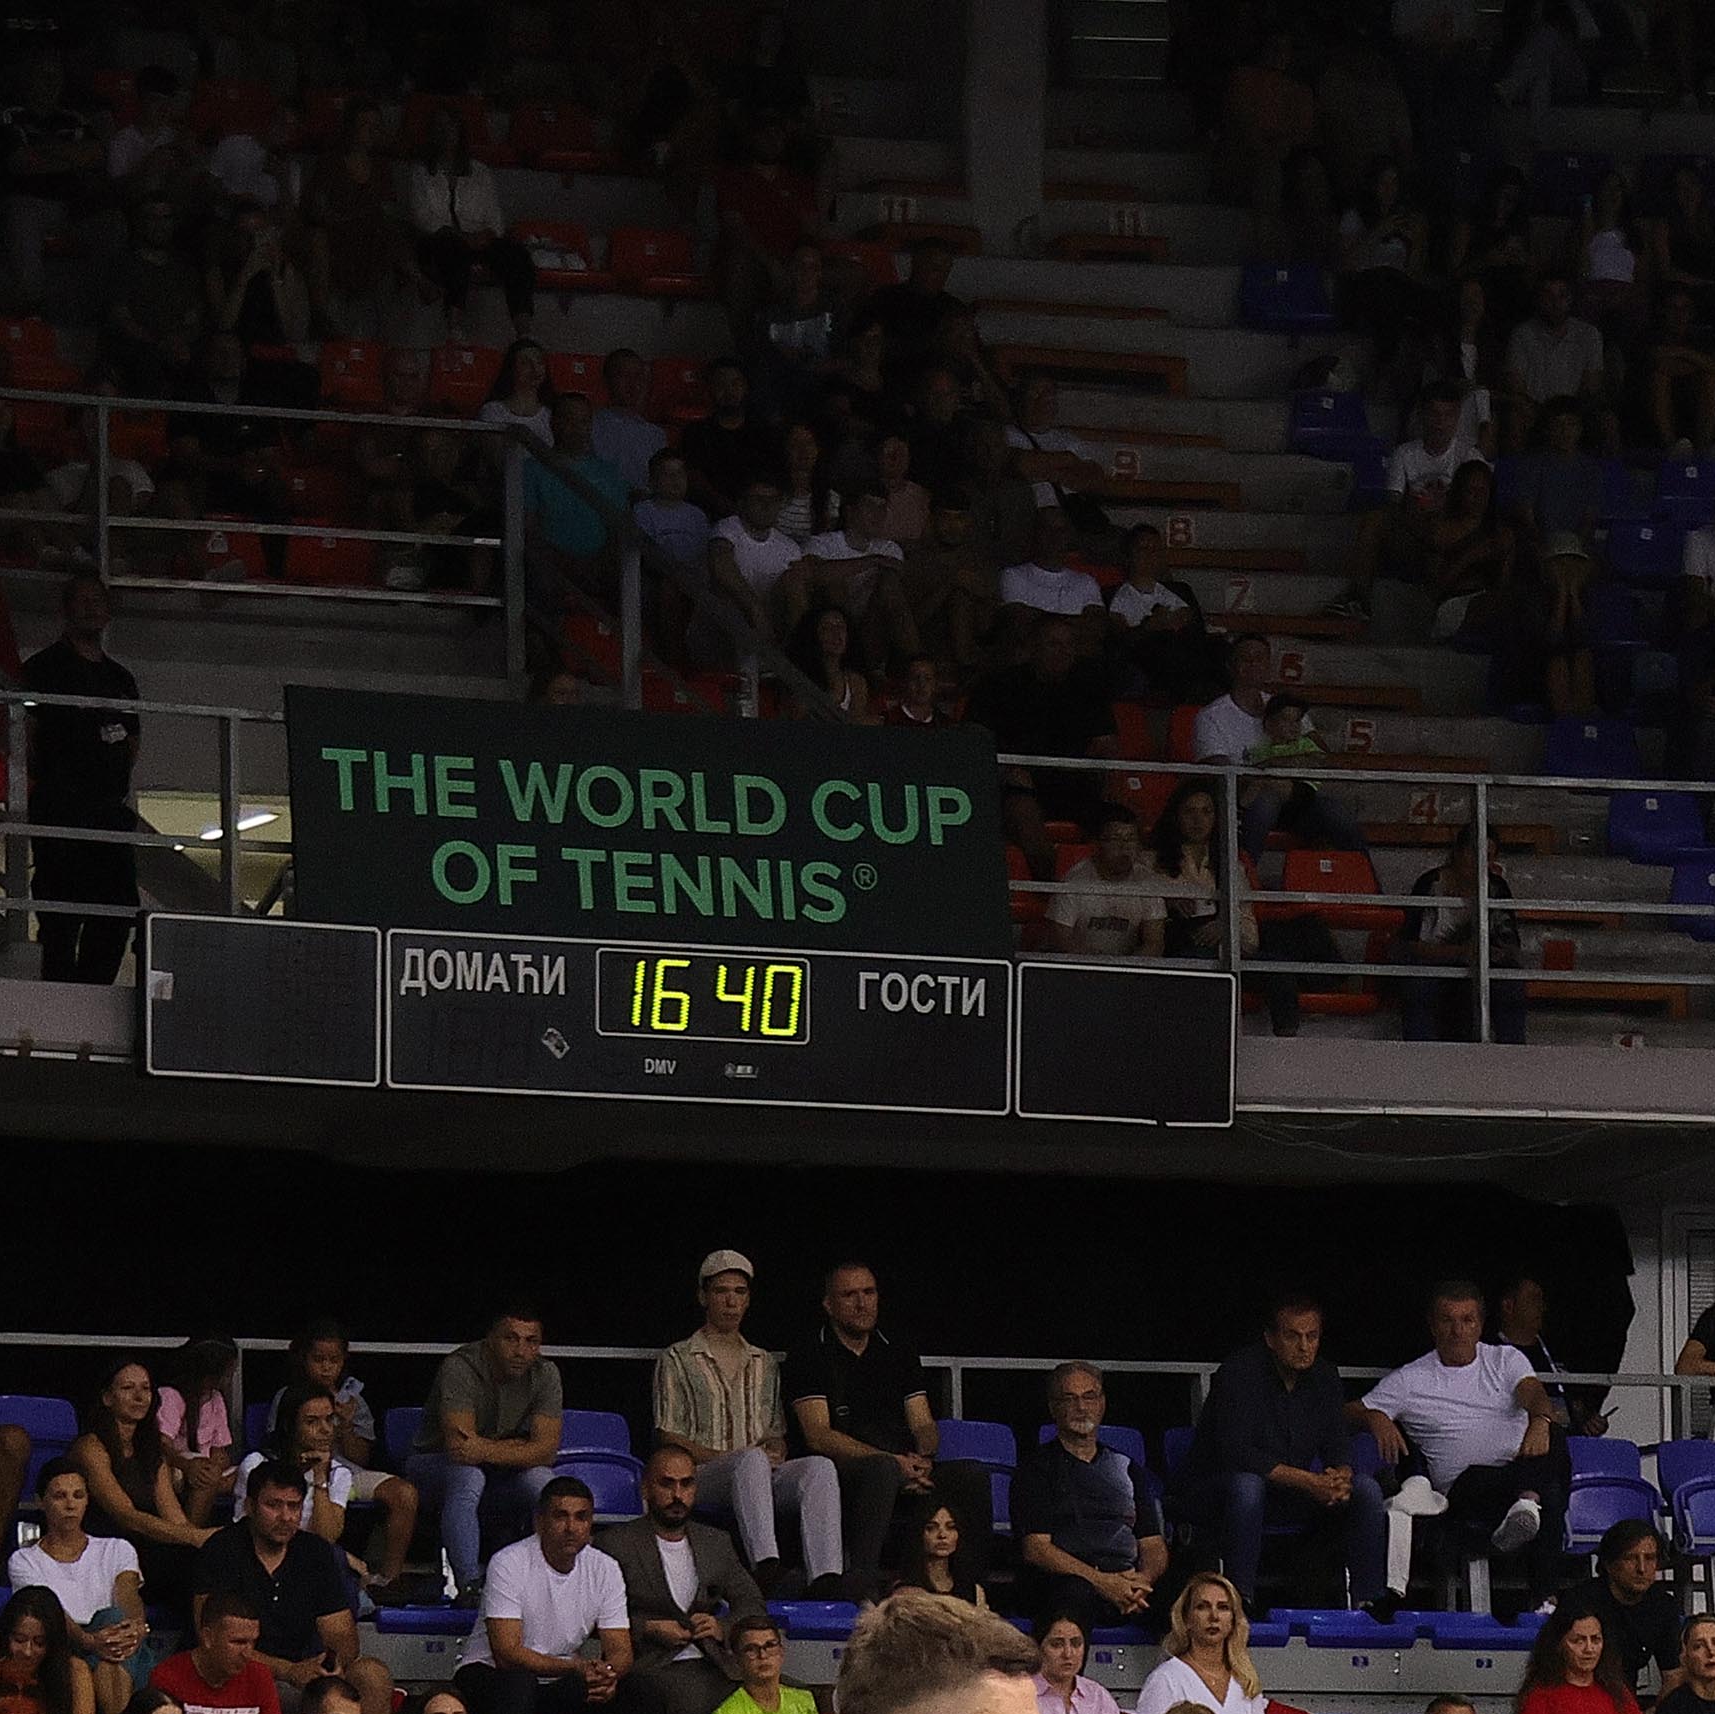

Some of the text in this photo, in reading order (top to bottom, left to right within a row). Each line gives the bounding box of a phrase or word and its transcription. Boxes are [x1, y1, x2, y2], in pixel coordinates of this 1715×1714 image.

[1168, 516, 1193, 545] 8
[1279, 651, 1304, 682] 6
[1347, 720, 1373, 752] 5
[321, 747, 973, 845] THE WORLD CUP
[1410, 792, 1439, 821] 4
[431, 840, 538, 906] OF
[399, 948, 566, 998] ДОМАЋИ
[630, 958, 803, 1037] 16 40
[858, 971, 986, 1017] ГОСТИ
[643, 1057, 677, 1075] DMV
